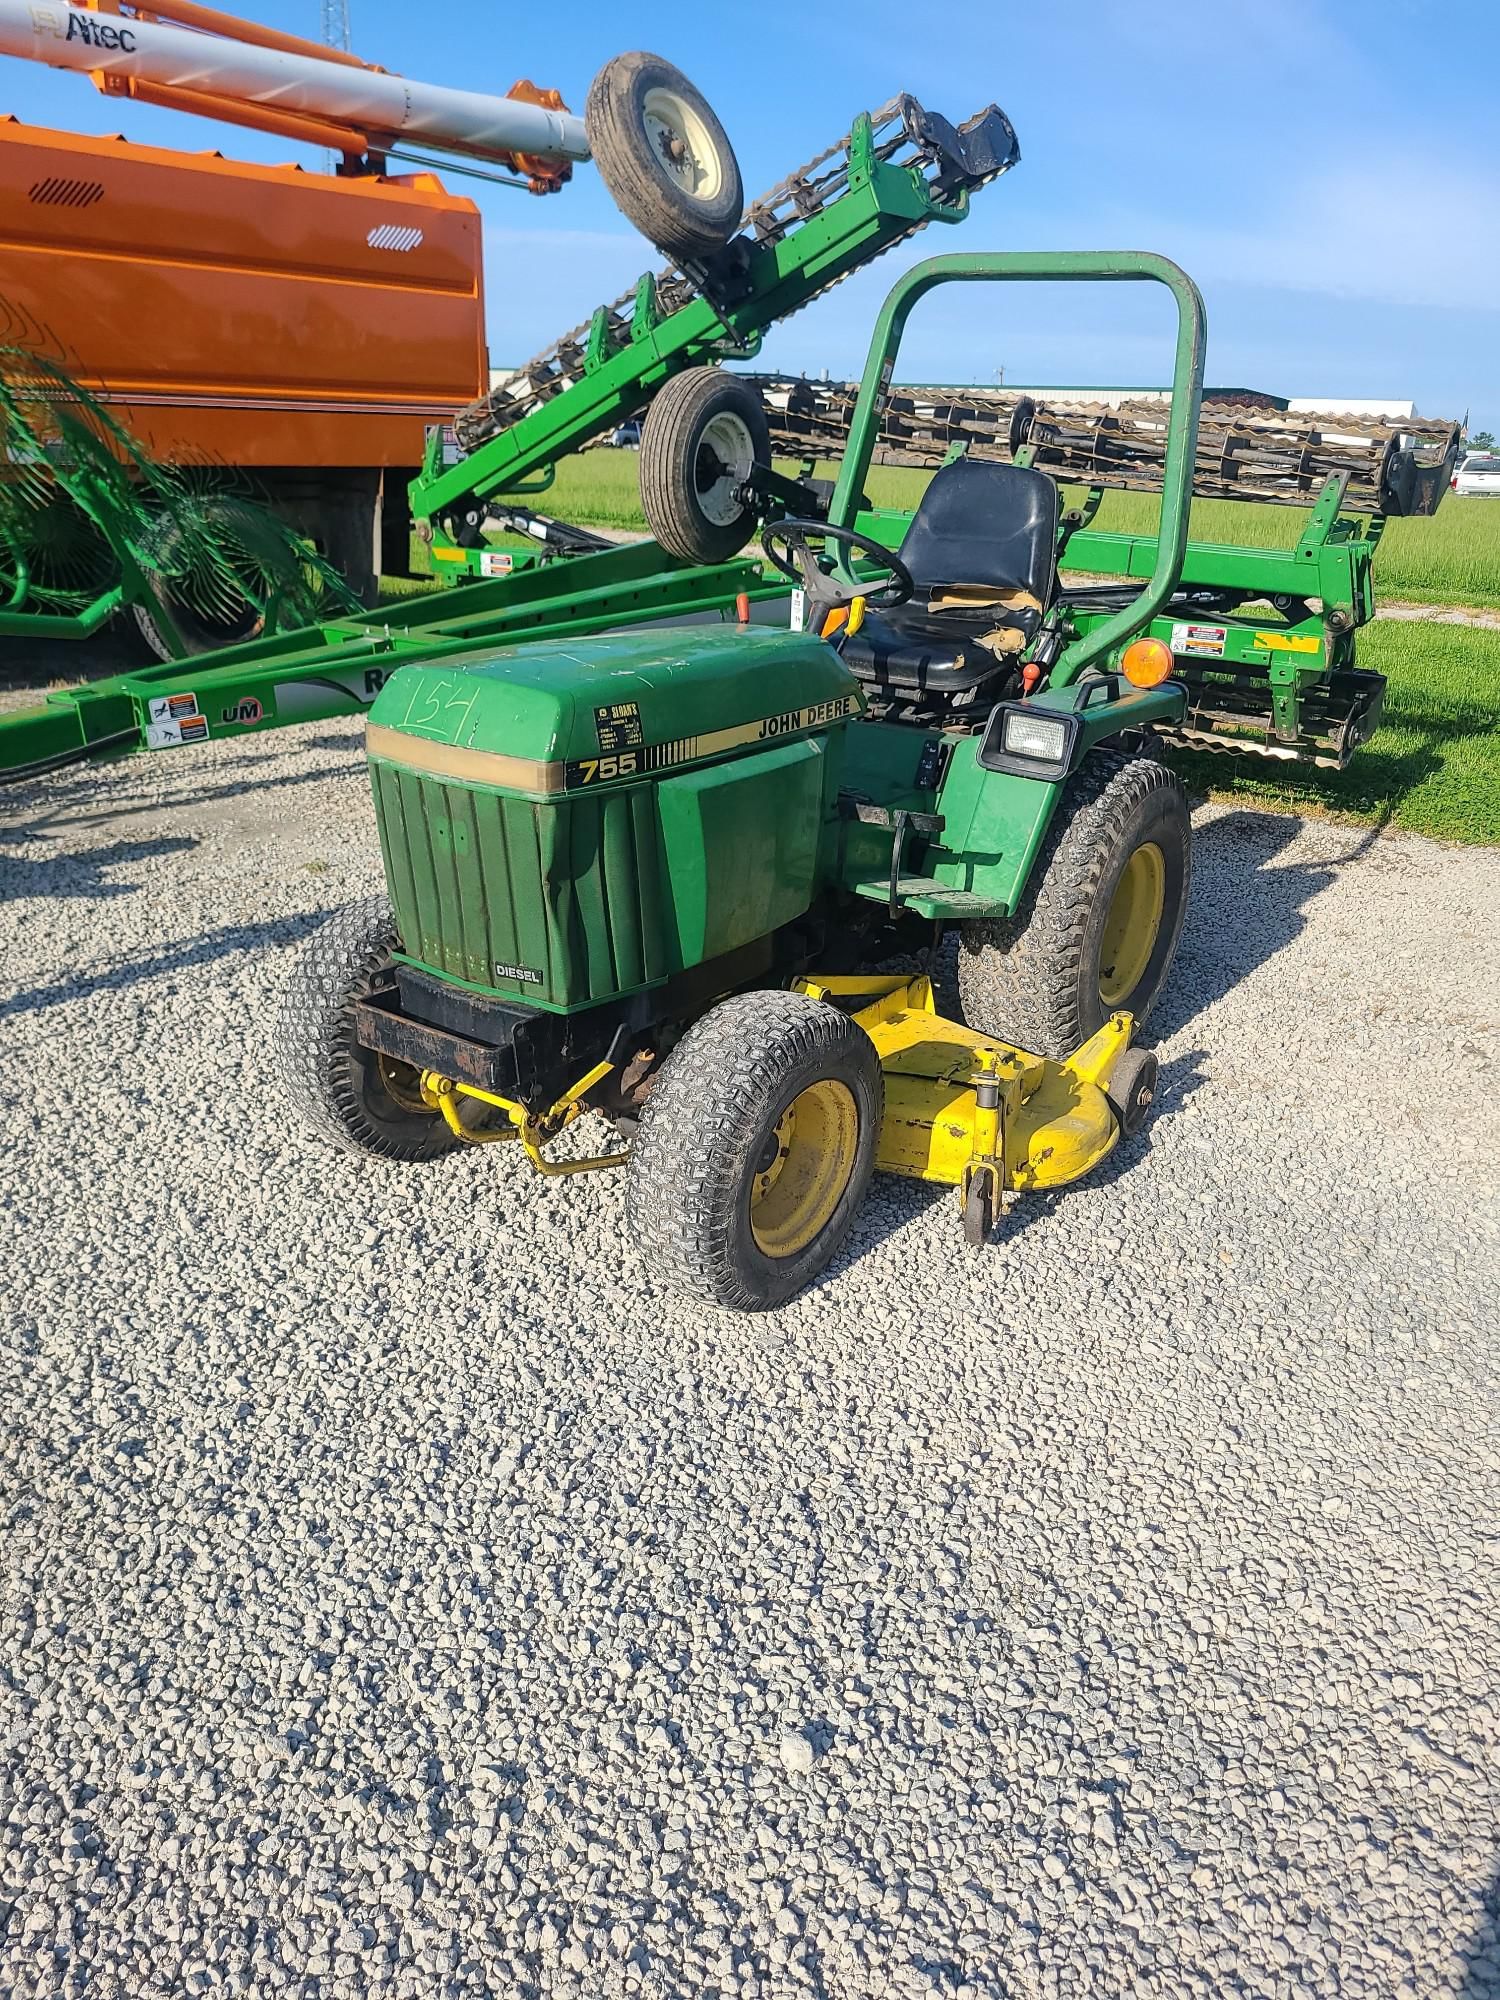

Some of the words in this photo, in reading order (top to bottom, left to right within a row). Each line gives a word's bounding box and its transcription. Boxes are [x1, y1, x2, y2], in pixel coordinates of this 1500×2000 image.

[222, 703, 259, 723] UM
[402, 677, 481, 745] 154
[758, 711, 801, 739] JOHN
[807, 698, 850, 725] DEERE
[578, 752, 637, 784] 755
[496, 965, 540, 983] DIESEL
